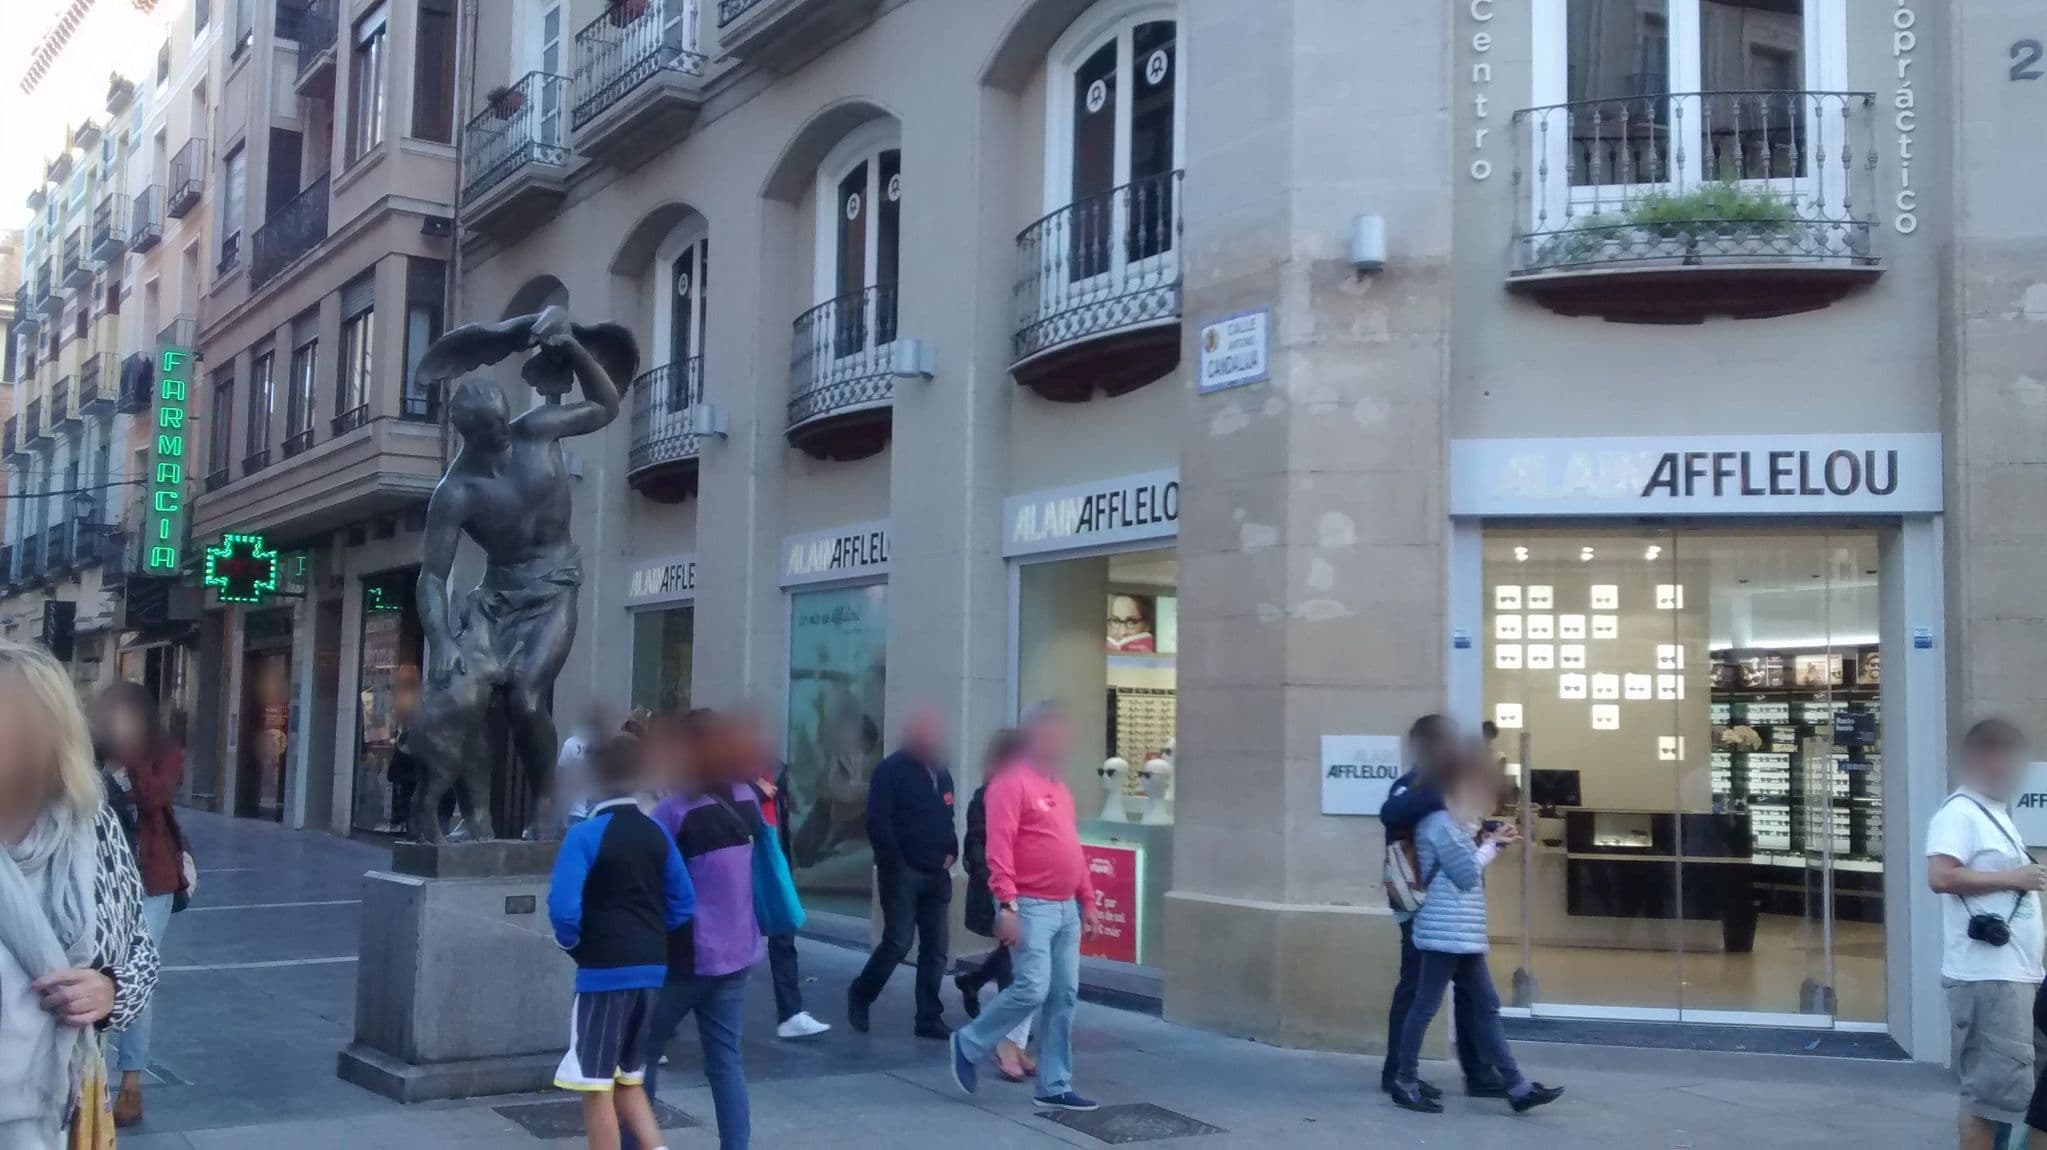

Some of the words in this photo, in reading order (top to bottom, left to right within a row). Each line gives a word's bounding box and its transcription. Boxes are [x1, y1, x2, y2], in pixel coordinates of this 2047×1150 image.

[2009, 39, 2044, 81] 2
[1470, 0, 1494, 180] Centro
[151, 351, 187, 568] FARMACIA
[1641, 449, 1898, 497] AFFLELOU
[830, 531, 890, 569] AFFLEL
[1326, 764, 1398, 780] AFFLELOU
